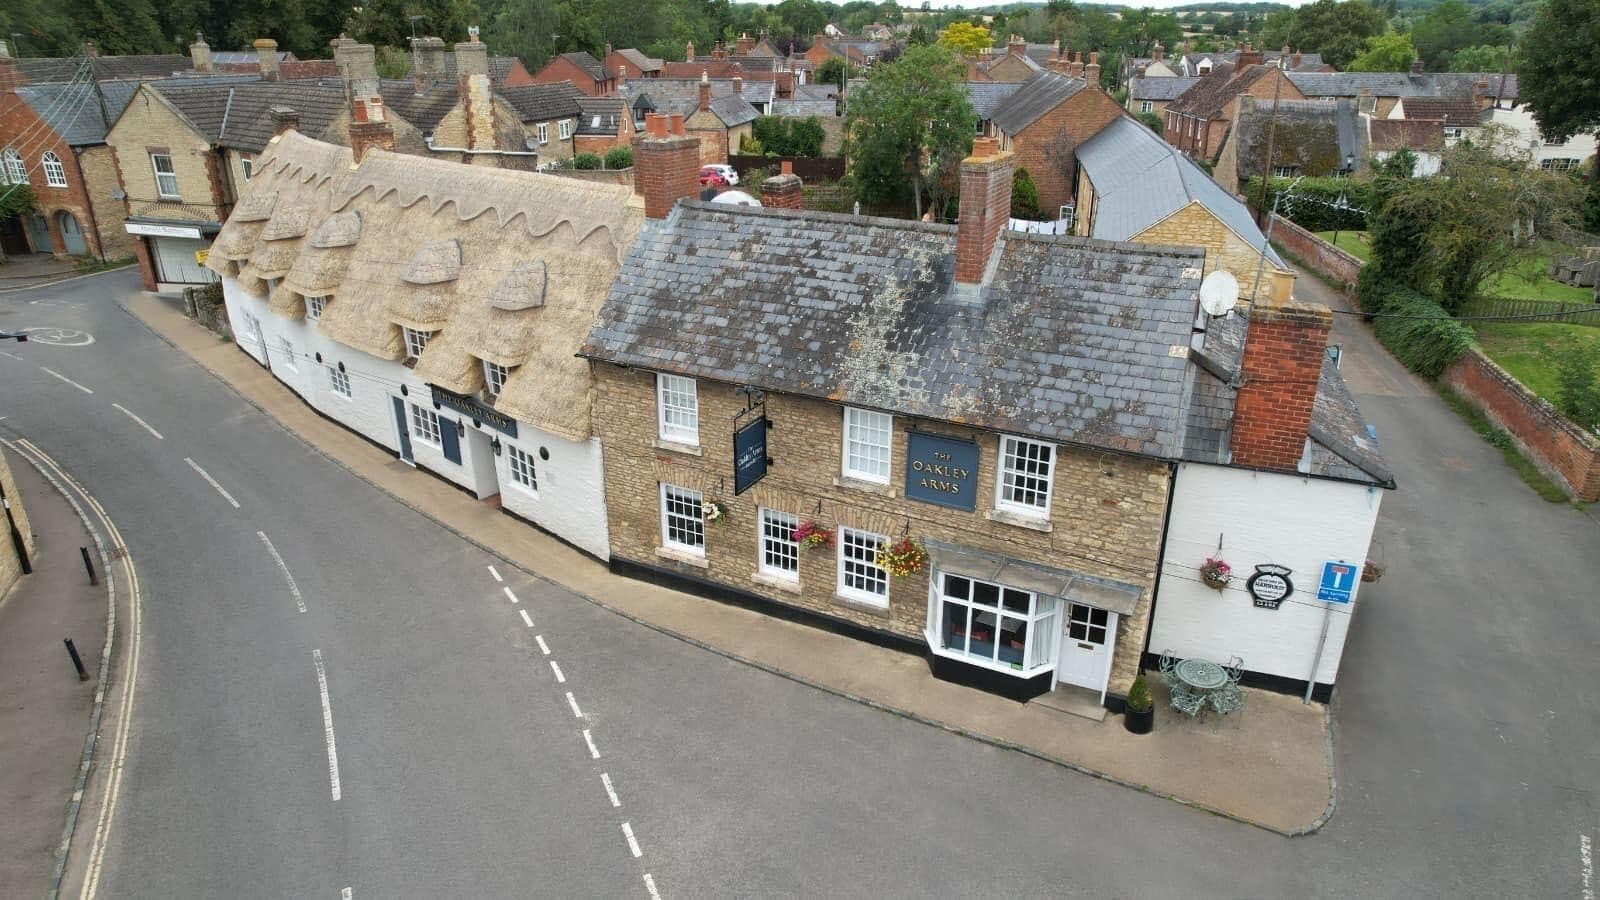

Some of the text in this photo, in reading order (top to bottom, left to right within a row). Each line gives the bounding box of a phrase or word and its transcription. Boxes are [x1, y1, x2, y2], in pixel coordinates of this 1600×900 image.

[933, 452, 952, 461] THE
[913, 460, 969, 480] OAKLEY
[920, 478, 960, 494] ARMS
